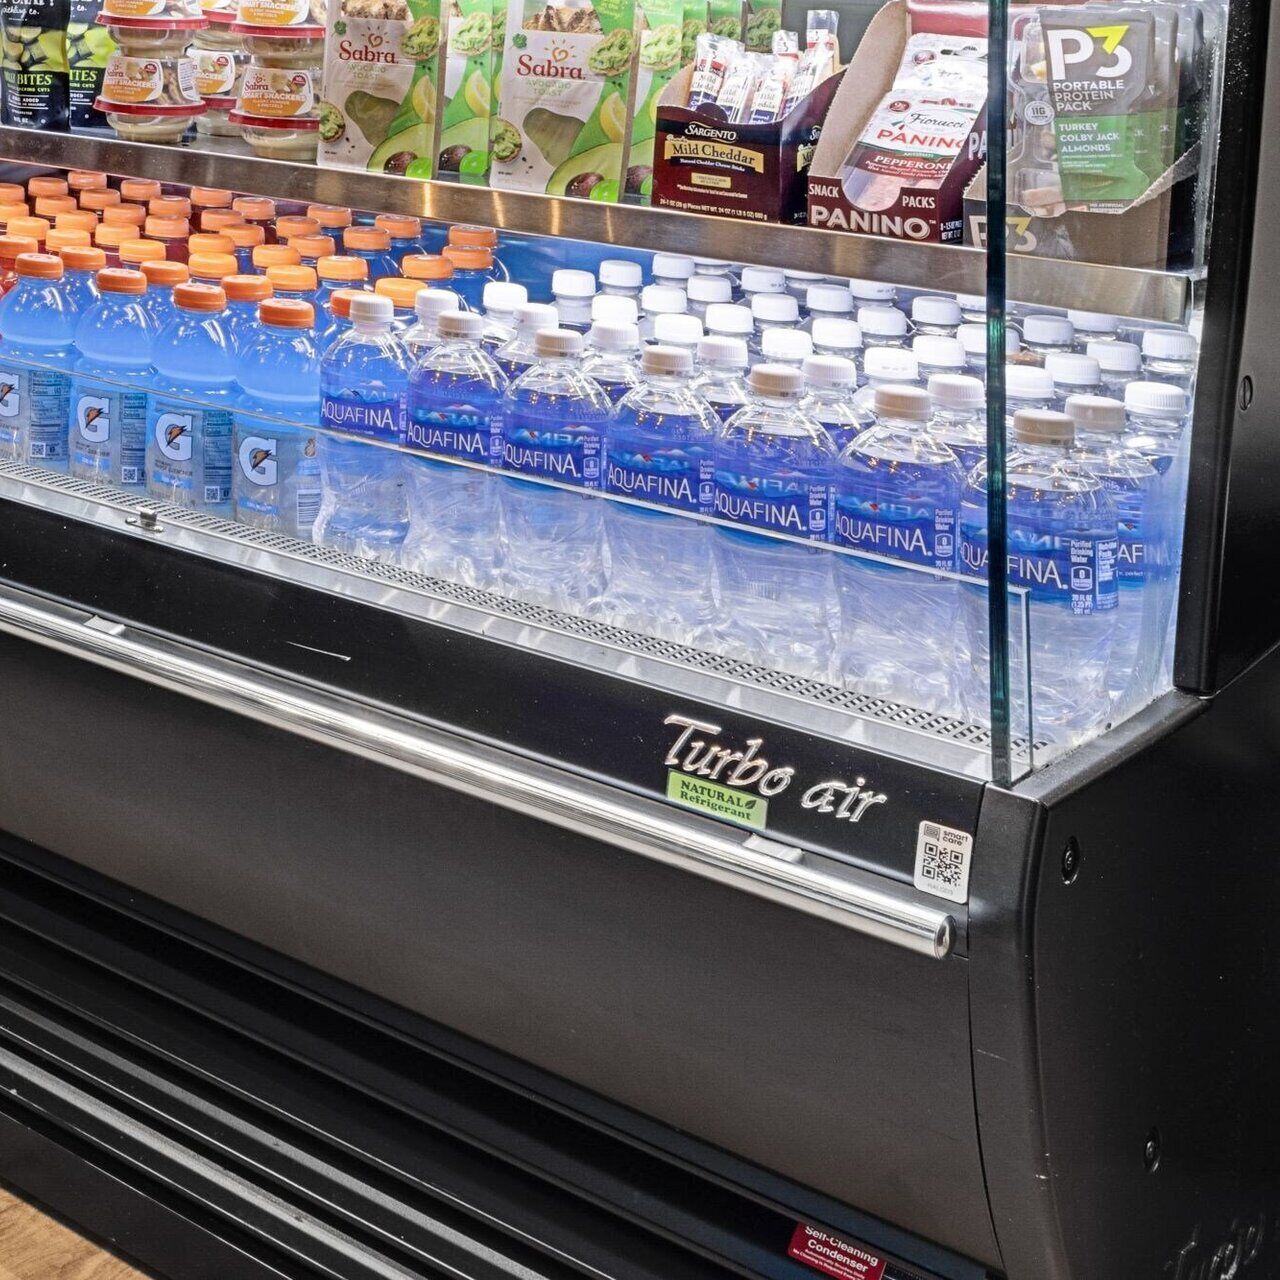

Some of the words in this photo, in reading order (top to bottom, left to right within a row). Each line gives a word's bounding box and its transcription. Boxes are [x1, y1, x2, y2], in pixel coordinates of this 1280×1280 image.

[338, 40, 399, 64] Sabra
[1046, 24, 1132, 81] P3
[516, 54, 586, 81] Sabra
[17, 73, 53, 86] BITES
[1053, 79, 1124, 92] PORTABLE
[1054, 91, 1115, 102] PROTEIN
[1056, 100, 1092, 112] PACK
[910, 111, 968, 129] Fiorucci
[1058, 122, 1099, 132] TURKEY
[685, 123, 738, 141] SARGENTO
[1060, 132, 1094, 142] COLBY
[1095, 132, 1121, 141] JACK
[672, 143, 700, 155] Mild
[701, 144, 756, 165] Cheddar
[1061, 142, 1112, 153] ALMONDS
[808, 183, 840, 198] SNACK
[901, 195, 937, 210] PACKS
[321, 398, 398, 431] AQUAFINA
[155, 412, 193, 461] G
[407, 421, 488, 456] AQUAFINA
[239, 436, 279, 487] G
[607, 462, 697, 504] AQUAFINA
[714, 487, 807, 532] AQUAFINA
[662, 714, 796, 797] Turbo
[800, 776, 888, 822] air
[679, 789, 752, 821] Refrigerant
[681, 779, 744, 809] NATURAL
[942, 835, 963, 847] care
[943, 830, 969, 842] smart
[804, 1225, 880, 1268] Self-Cleaning
[807, 1238, 869, 1273] Condenser
